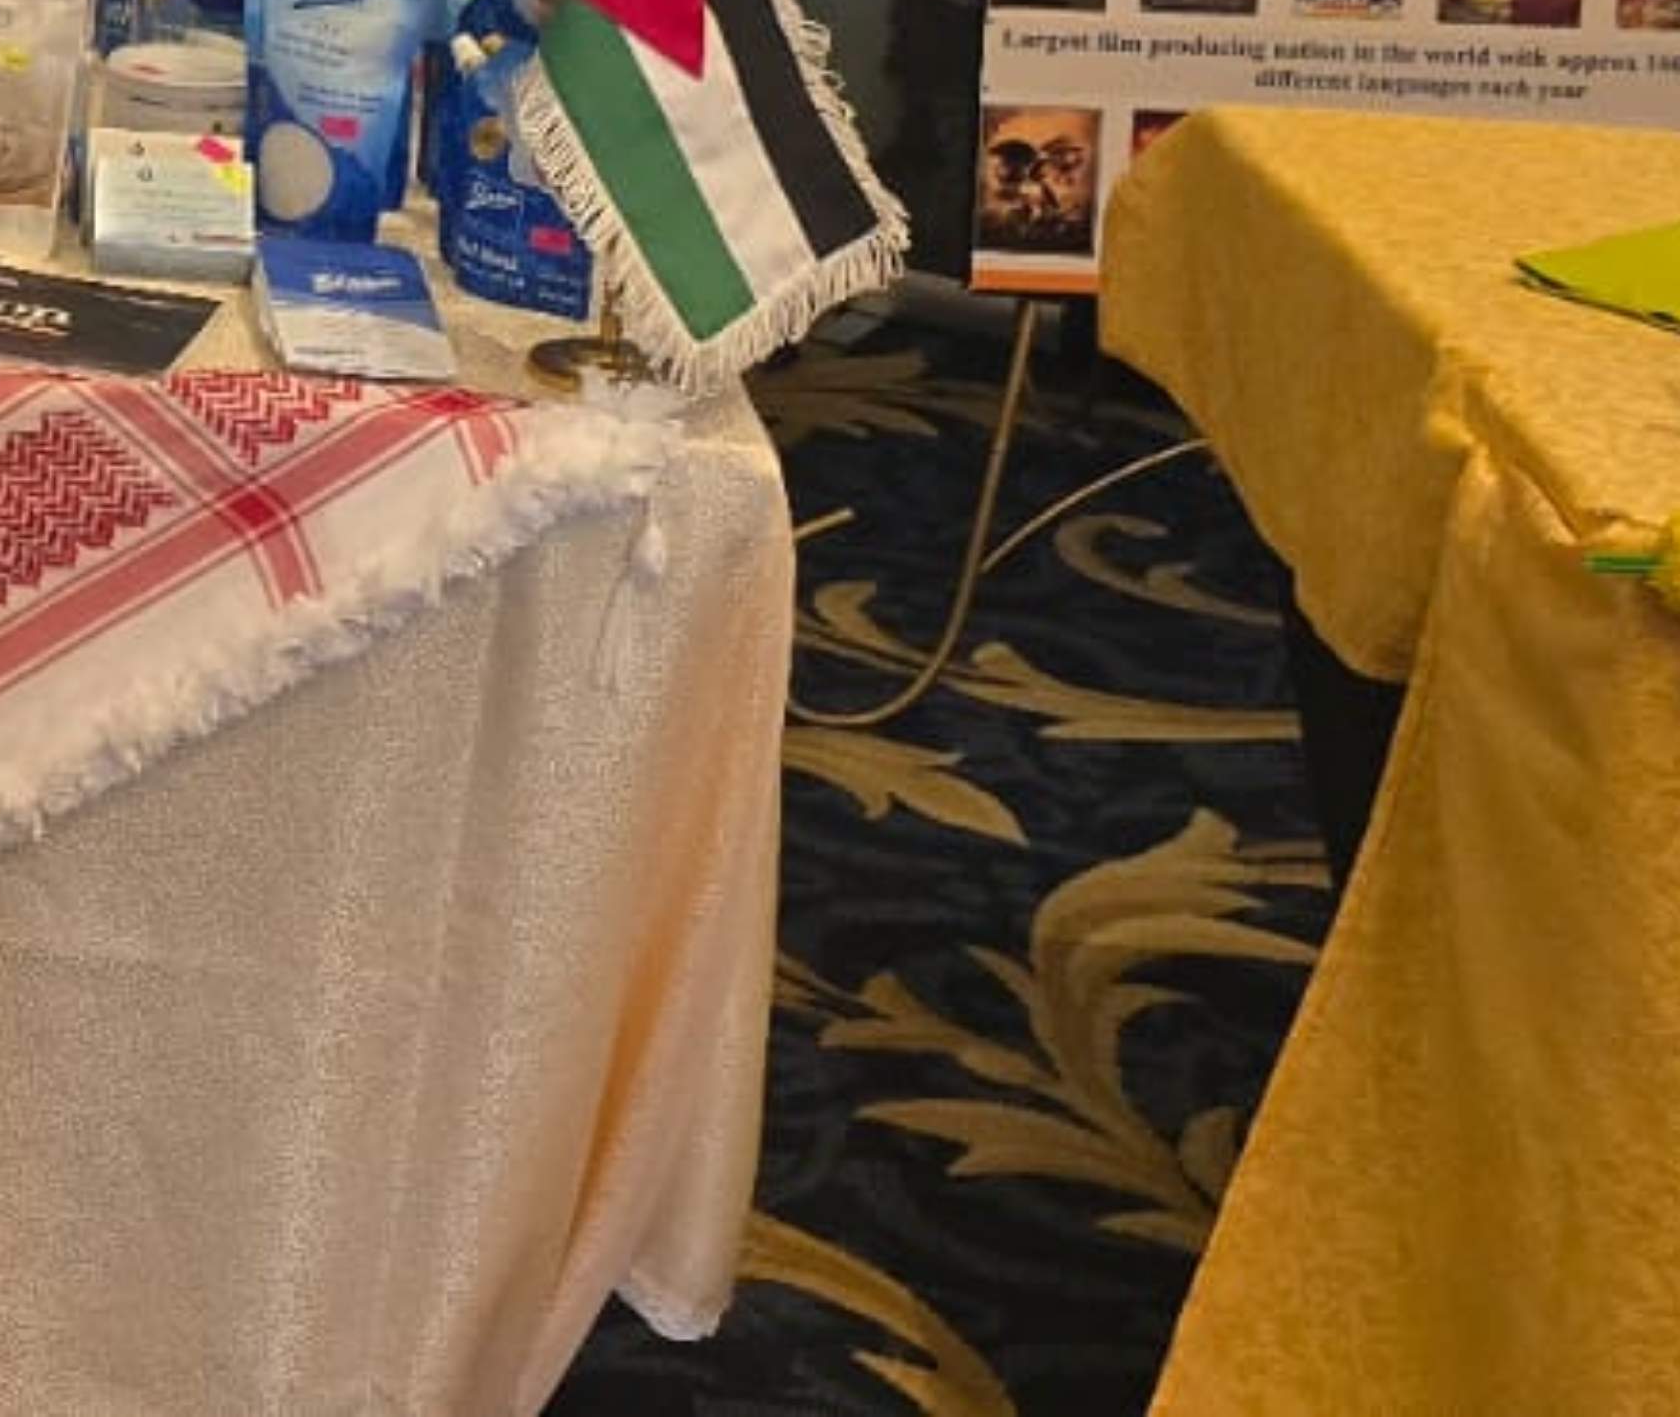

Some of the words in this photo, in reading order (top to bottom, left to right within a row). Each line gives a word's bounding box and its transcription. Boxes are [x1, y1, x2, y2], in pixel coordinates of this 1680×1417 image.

[1002, 28, 1088, 56] Largest
[1097, 31, 1141, 54] film
[1150, 35, 1265, 61] producing
[1274, 39, 1344, 60] nation
[1354, 42, 1374, 60] in
[1382, 43, 1415, 63] the
[1424, 45, 1490, 66] world
[1499, 46, 1548, 68] with
[1255, 69, 1350, 90] different
[1357, 74, 1472, 99] languages
[1480, 79, 1529, 97] each
[1538, 84, 1587, 103] year
